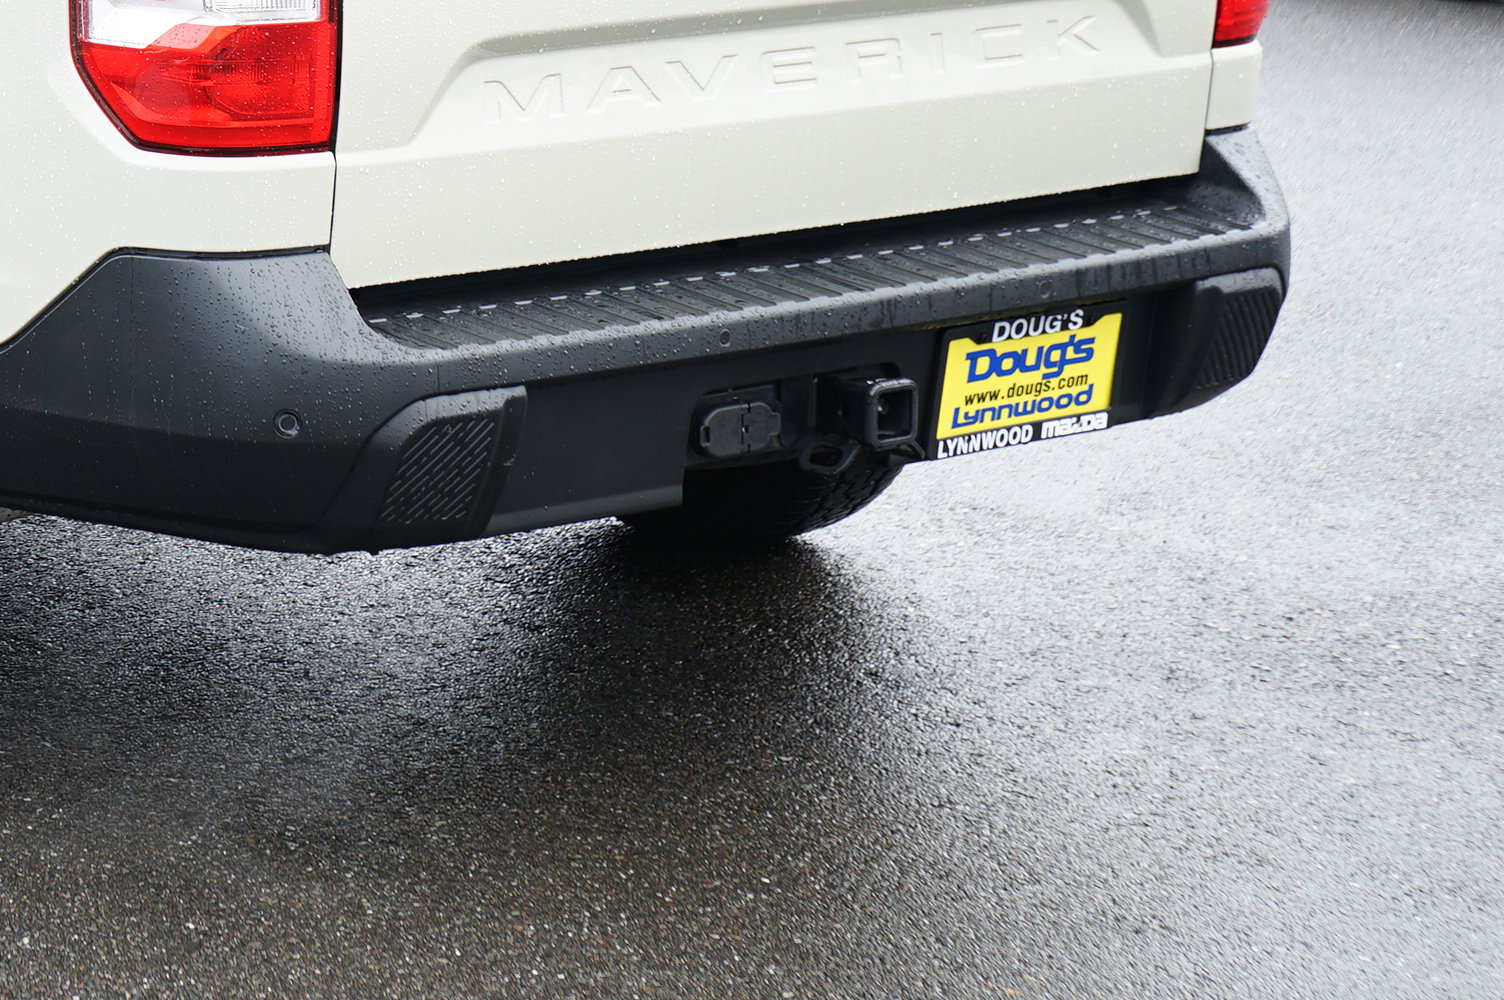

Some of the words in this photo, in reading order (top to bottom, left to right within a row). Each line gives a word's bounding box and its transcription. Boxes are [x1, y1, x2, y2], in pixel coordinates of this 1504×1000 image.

[483, 14, 1102, 126] MAVERICK
[991, 308, 1085, 343] DOUG'S
[951, 383, 1095, 430] Lynnwood
[964, 373, 1089, 407] www.dougs.com
[936, 423, 1034, 460] LYNNWOOD
